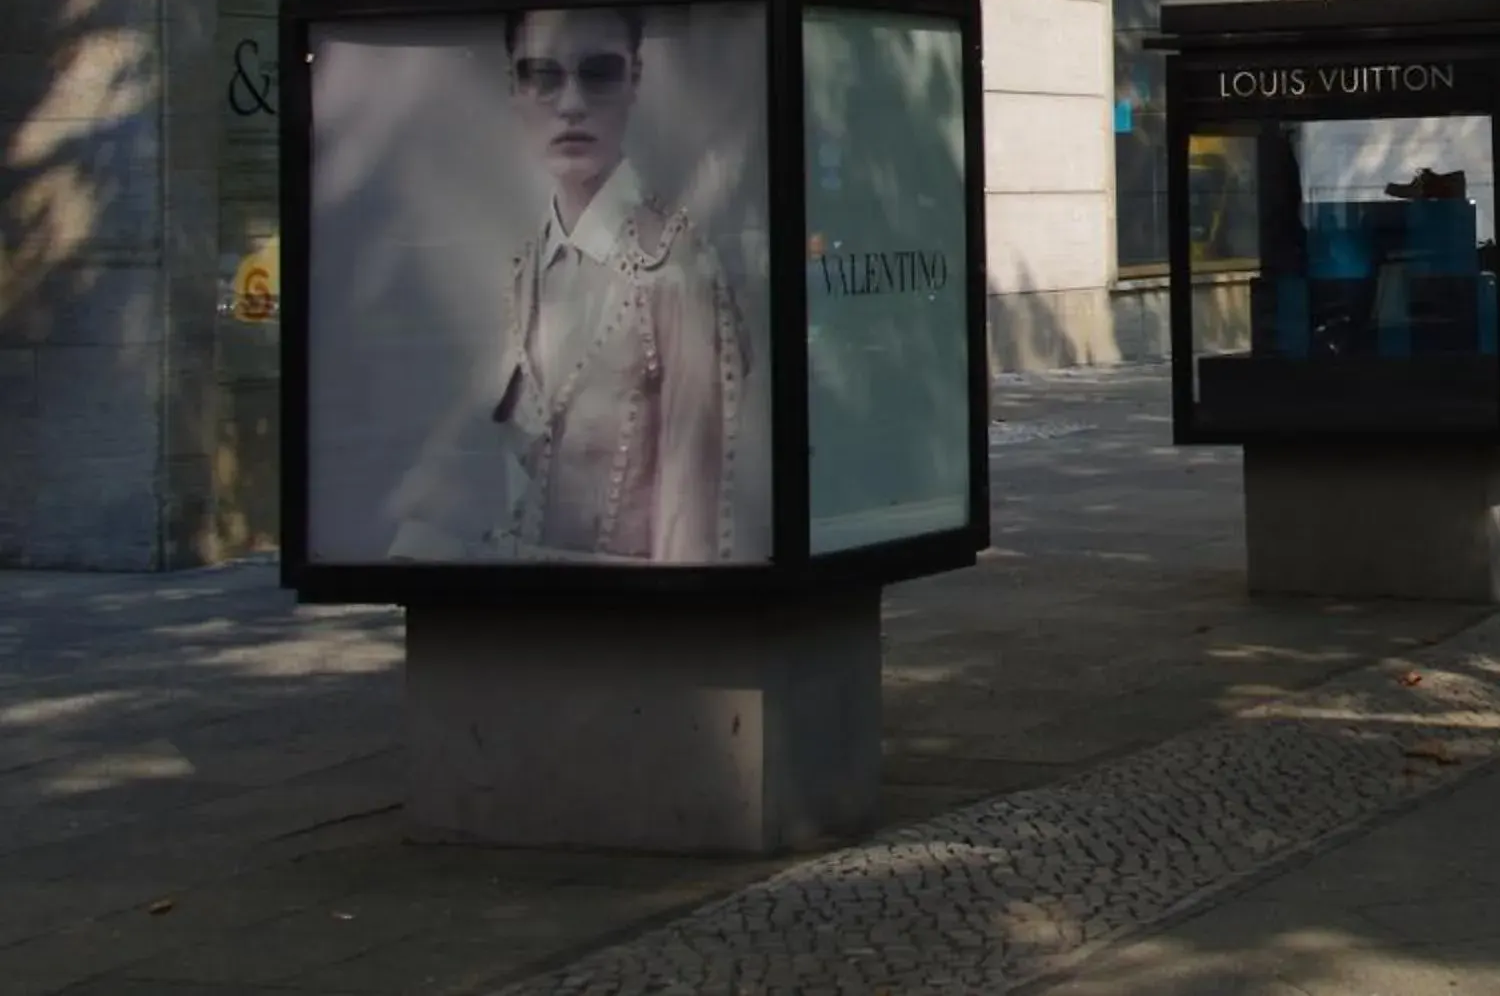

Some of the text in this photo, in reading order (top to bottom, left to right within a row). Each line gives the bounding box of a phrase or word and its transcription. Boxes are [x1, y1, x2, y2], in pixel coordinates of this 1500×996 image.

[1219, 64, 1455, 97] LOUIS VUITTON
[821, 248, 948, 296] VALENTINO
